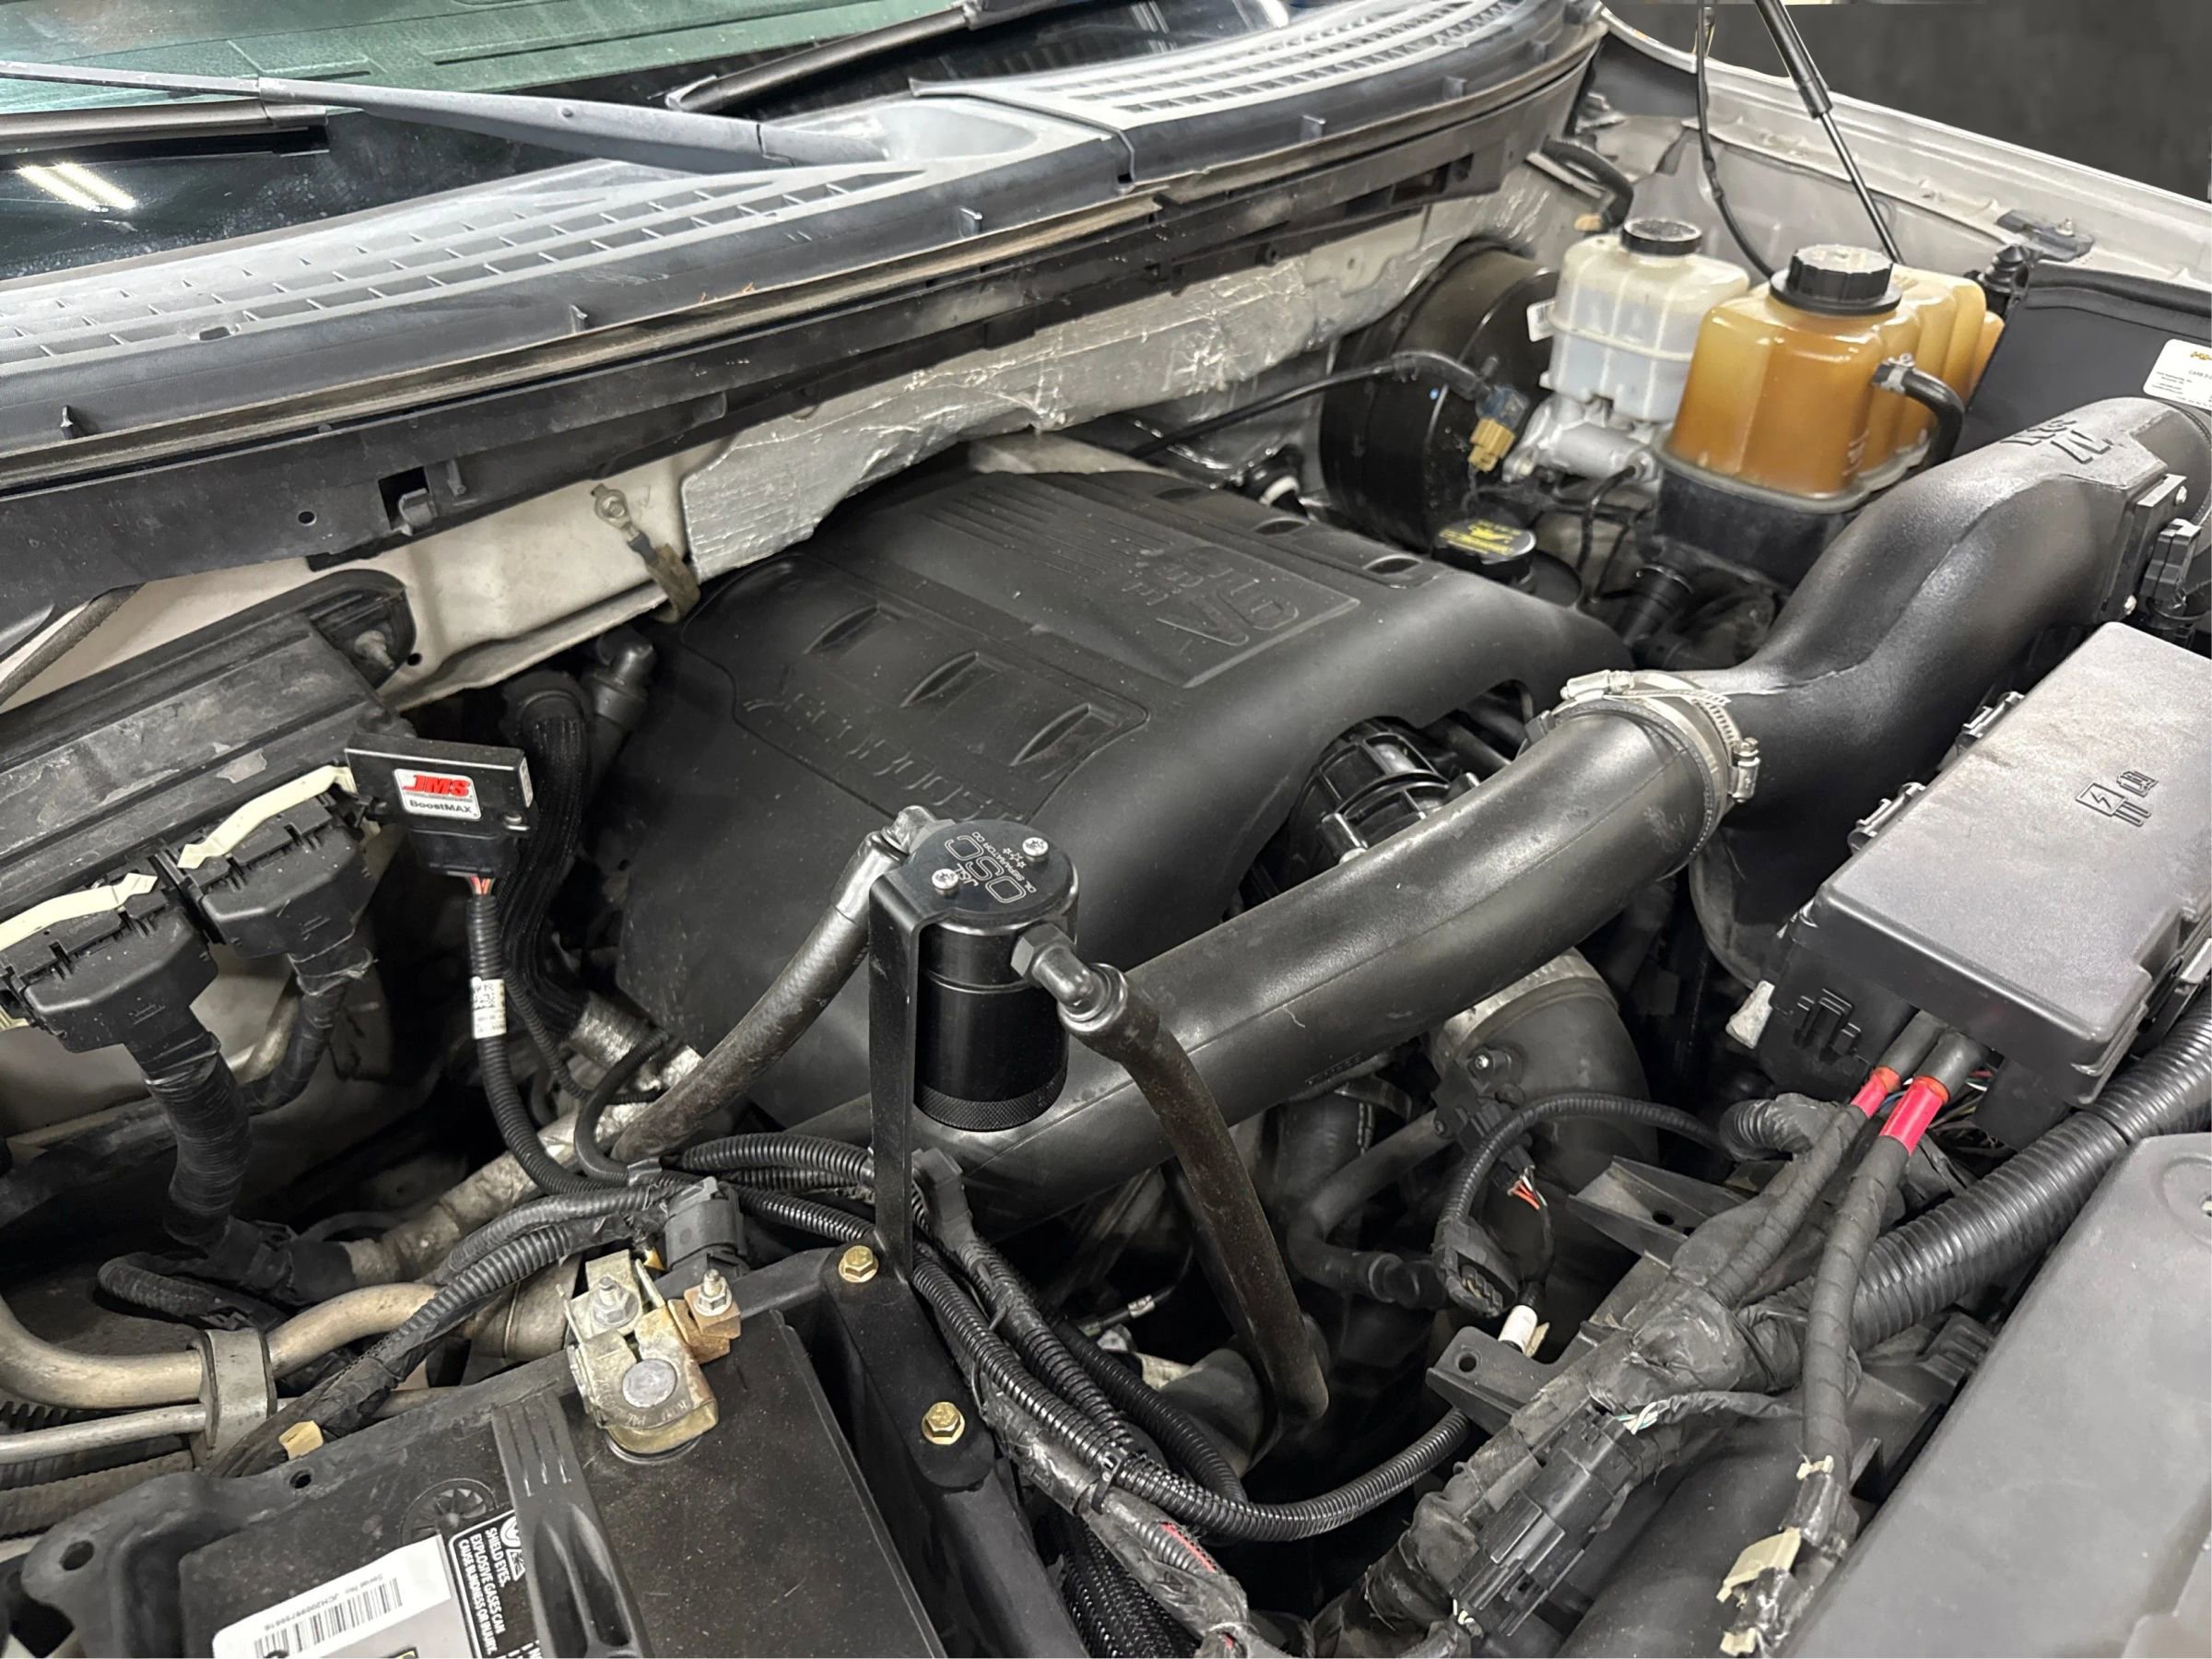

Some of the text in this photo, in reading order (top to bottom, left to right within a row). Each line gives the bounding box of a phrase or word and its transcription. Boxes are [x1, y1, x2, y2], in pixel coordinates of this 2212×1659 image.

[1156, 579, 1299, 647] V6
[403, 774, 471, 797] JMS
[409, 799, 473, 814] BoostMAX
[944, 834, 1027, 903] OSC
[982, 842, 1025, 882] SEPARATOR
[1024, 881, 1037, 893] OIL
[470, 1534, 506, 1634] EXPLOSIVE GASES CAN
[485, 1527, 512, 1587] SHIELD EYES.
[458, 1539, 499, 1655] CAUSE BLINDNESS OR INJURY.
